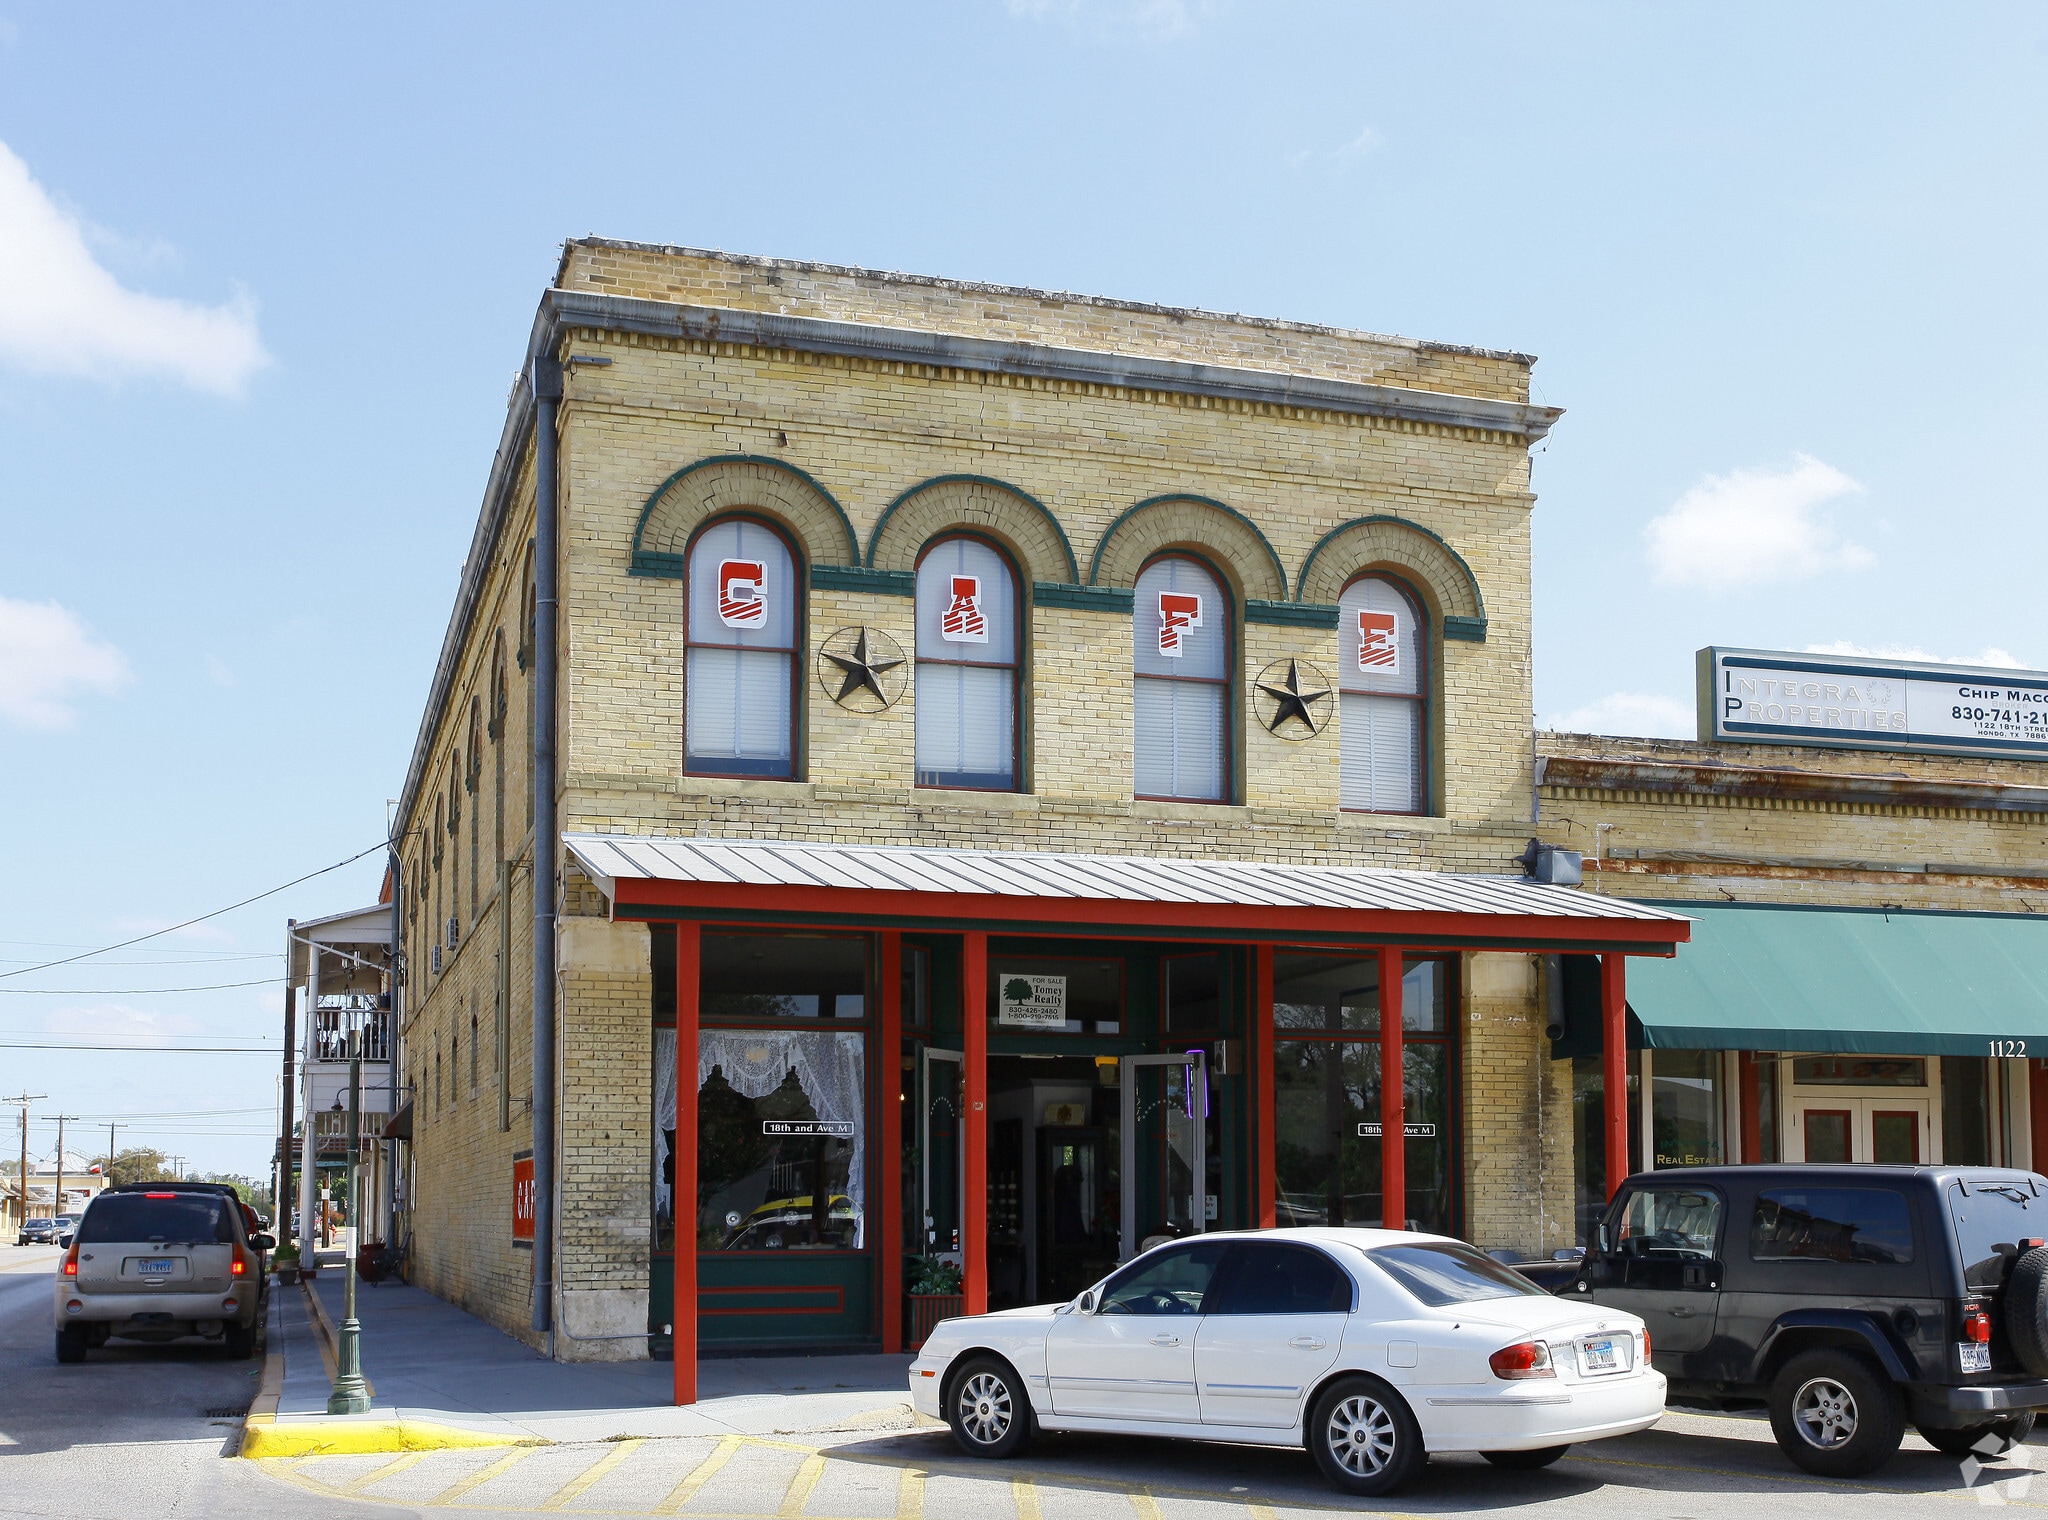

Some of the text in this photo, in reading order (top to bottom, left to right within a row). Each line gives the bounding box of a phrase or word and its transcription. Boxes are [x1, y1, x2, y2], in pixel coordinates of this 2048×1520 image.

[1725, 670, 1863, 703] INTEGRA
[1724, 697, 1907, 731] PROPERTIES
[1974, 721, 1996, 729] 1122
[2000, 723, 2020, 731] 18TH
[2025, 732, 2048, 740] 7886
[1034, 985, 1063, 996] Tomey
[1034, 994, 1063, 1007] Realty
[1988, 1039, 2027, 1058] 1122
[769, 1124, 848, 1132] 18th and Ave M
[1363, 1126, 1382, 1134] 18th
[1656, 1154, 1684, 1165] REAL
